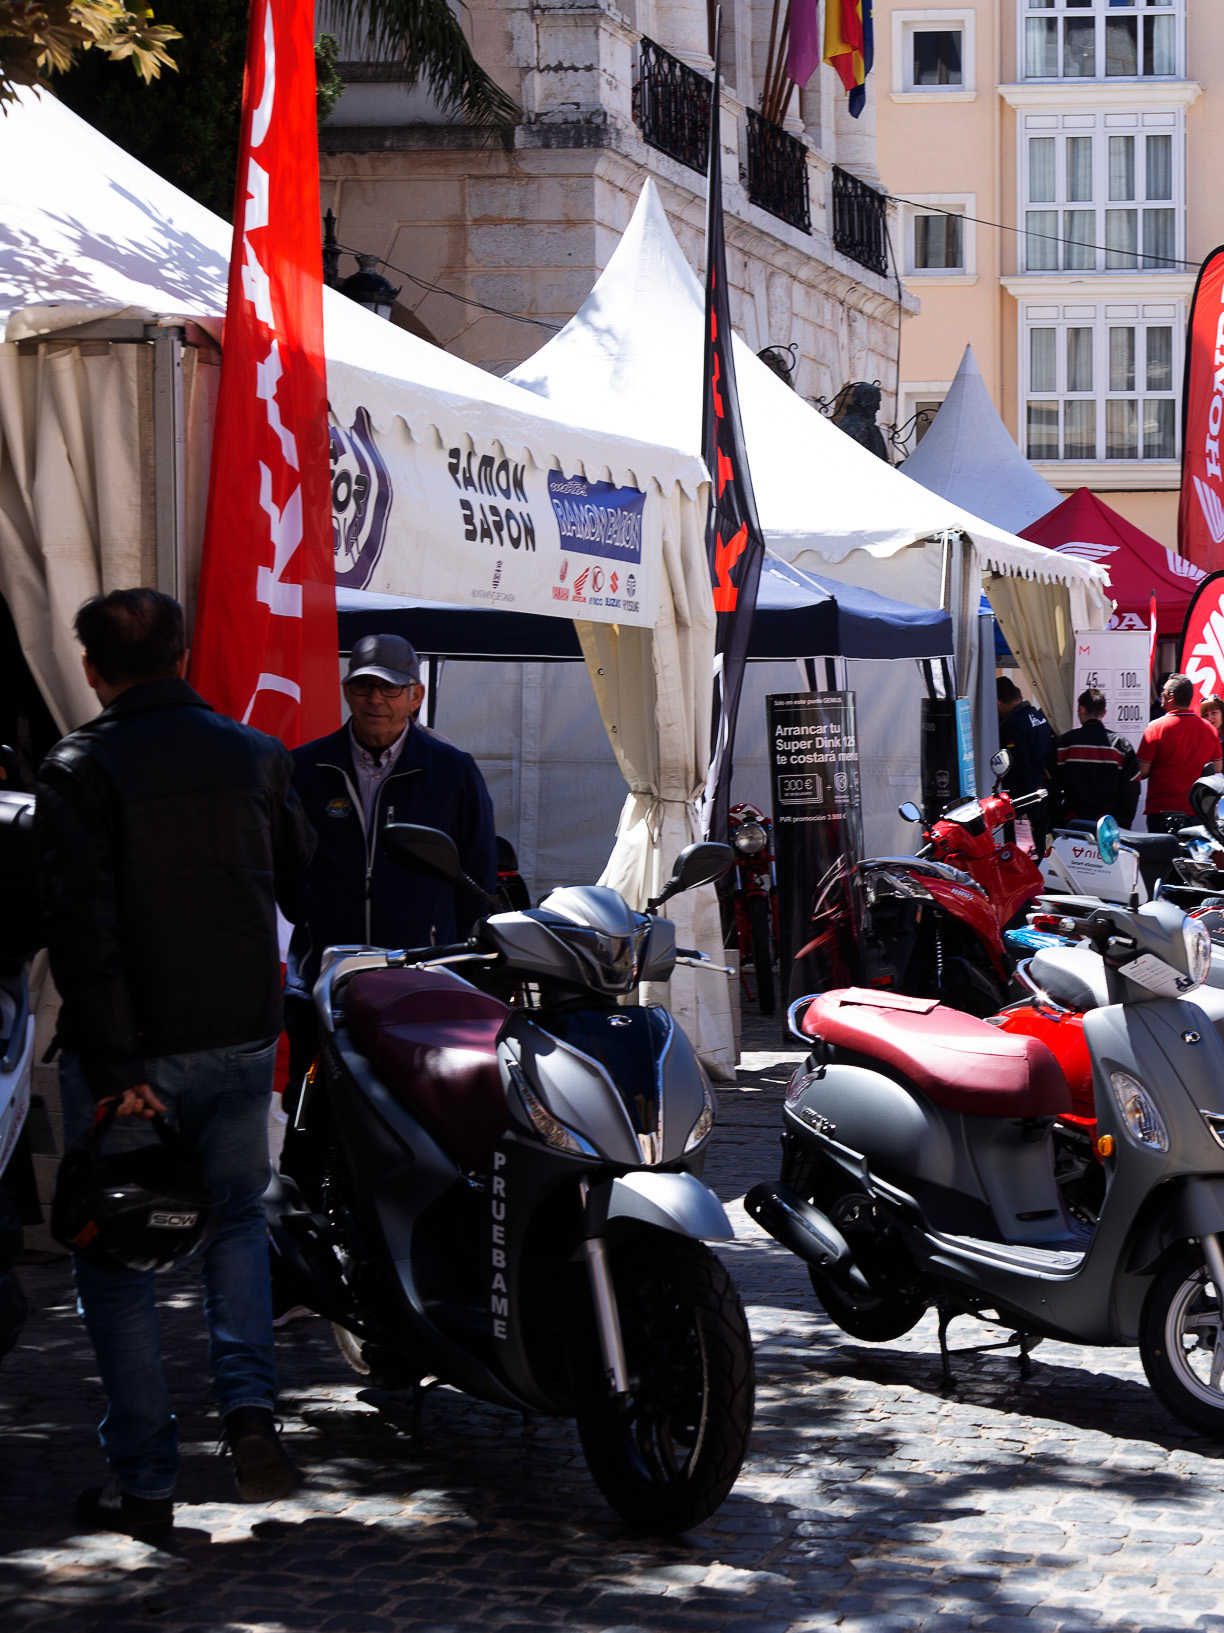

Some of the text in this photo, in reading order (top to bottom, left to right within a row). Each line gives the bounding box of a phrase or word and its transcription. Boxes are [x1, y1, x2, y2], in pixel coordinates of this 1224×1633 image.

[448, 448, 528, 503] RAMON
[459, 498, 536, 552] BARON
[776, 723, 840, 736] Arrancar tu
[776, 739, 814, 752] Super
[816, 737, 840, 748] Dink
[777, 754, 788, 764] te
[790, 751, 836, 764] costará
[784, 779, 803, 791] 300
[490, 1152, 508, 1339] PRUEBAME
